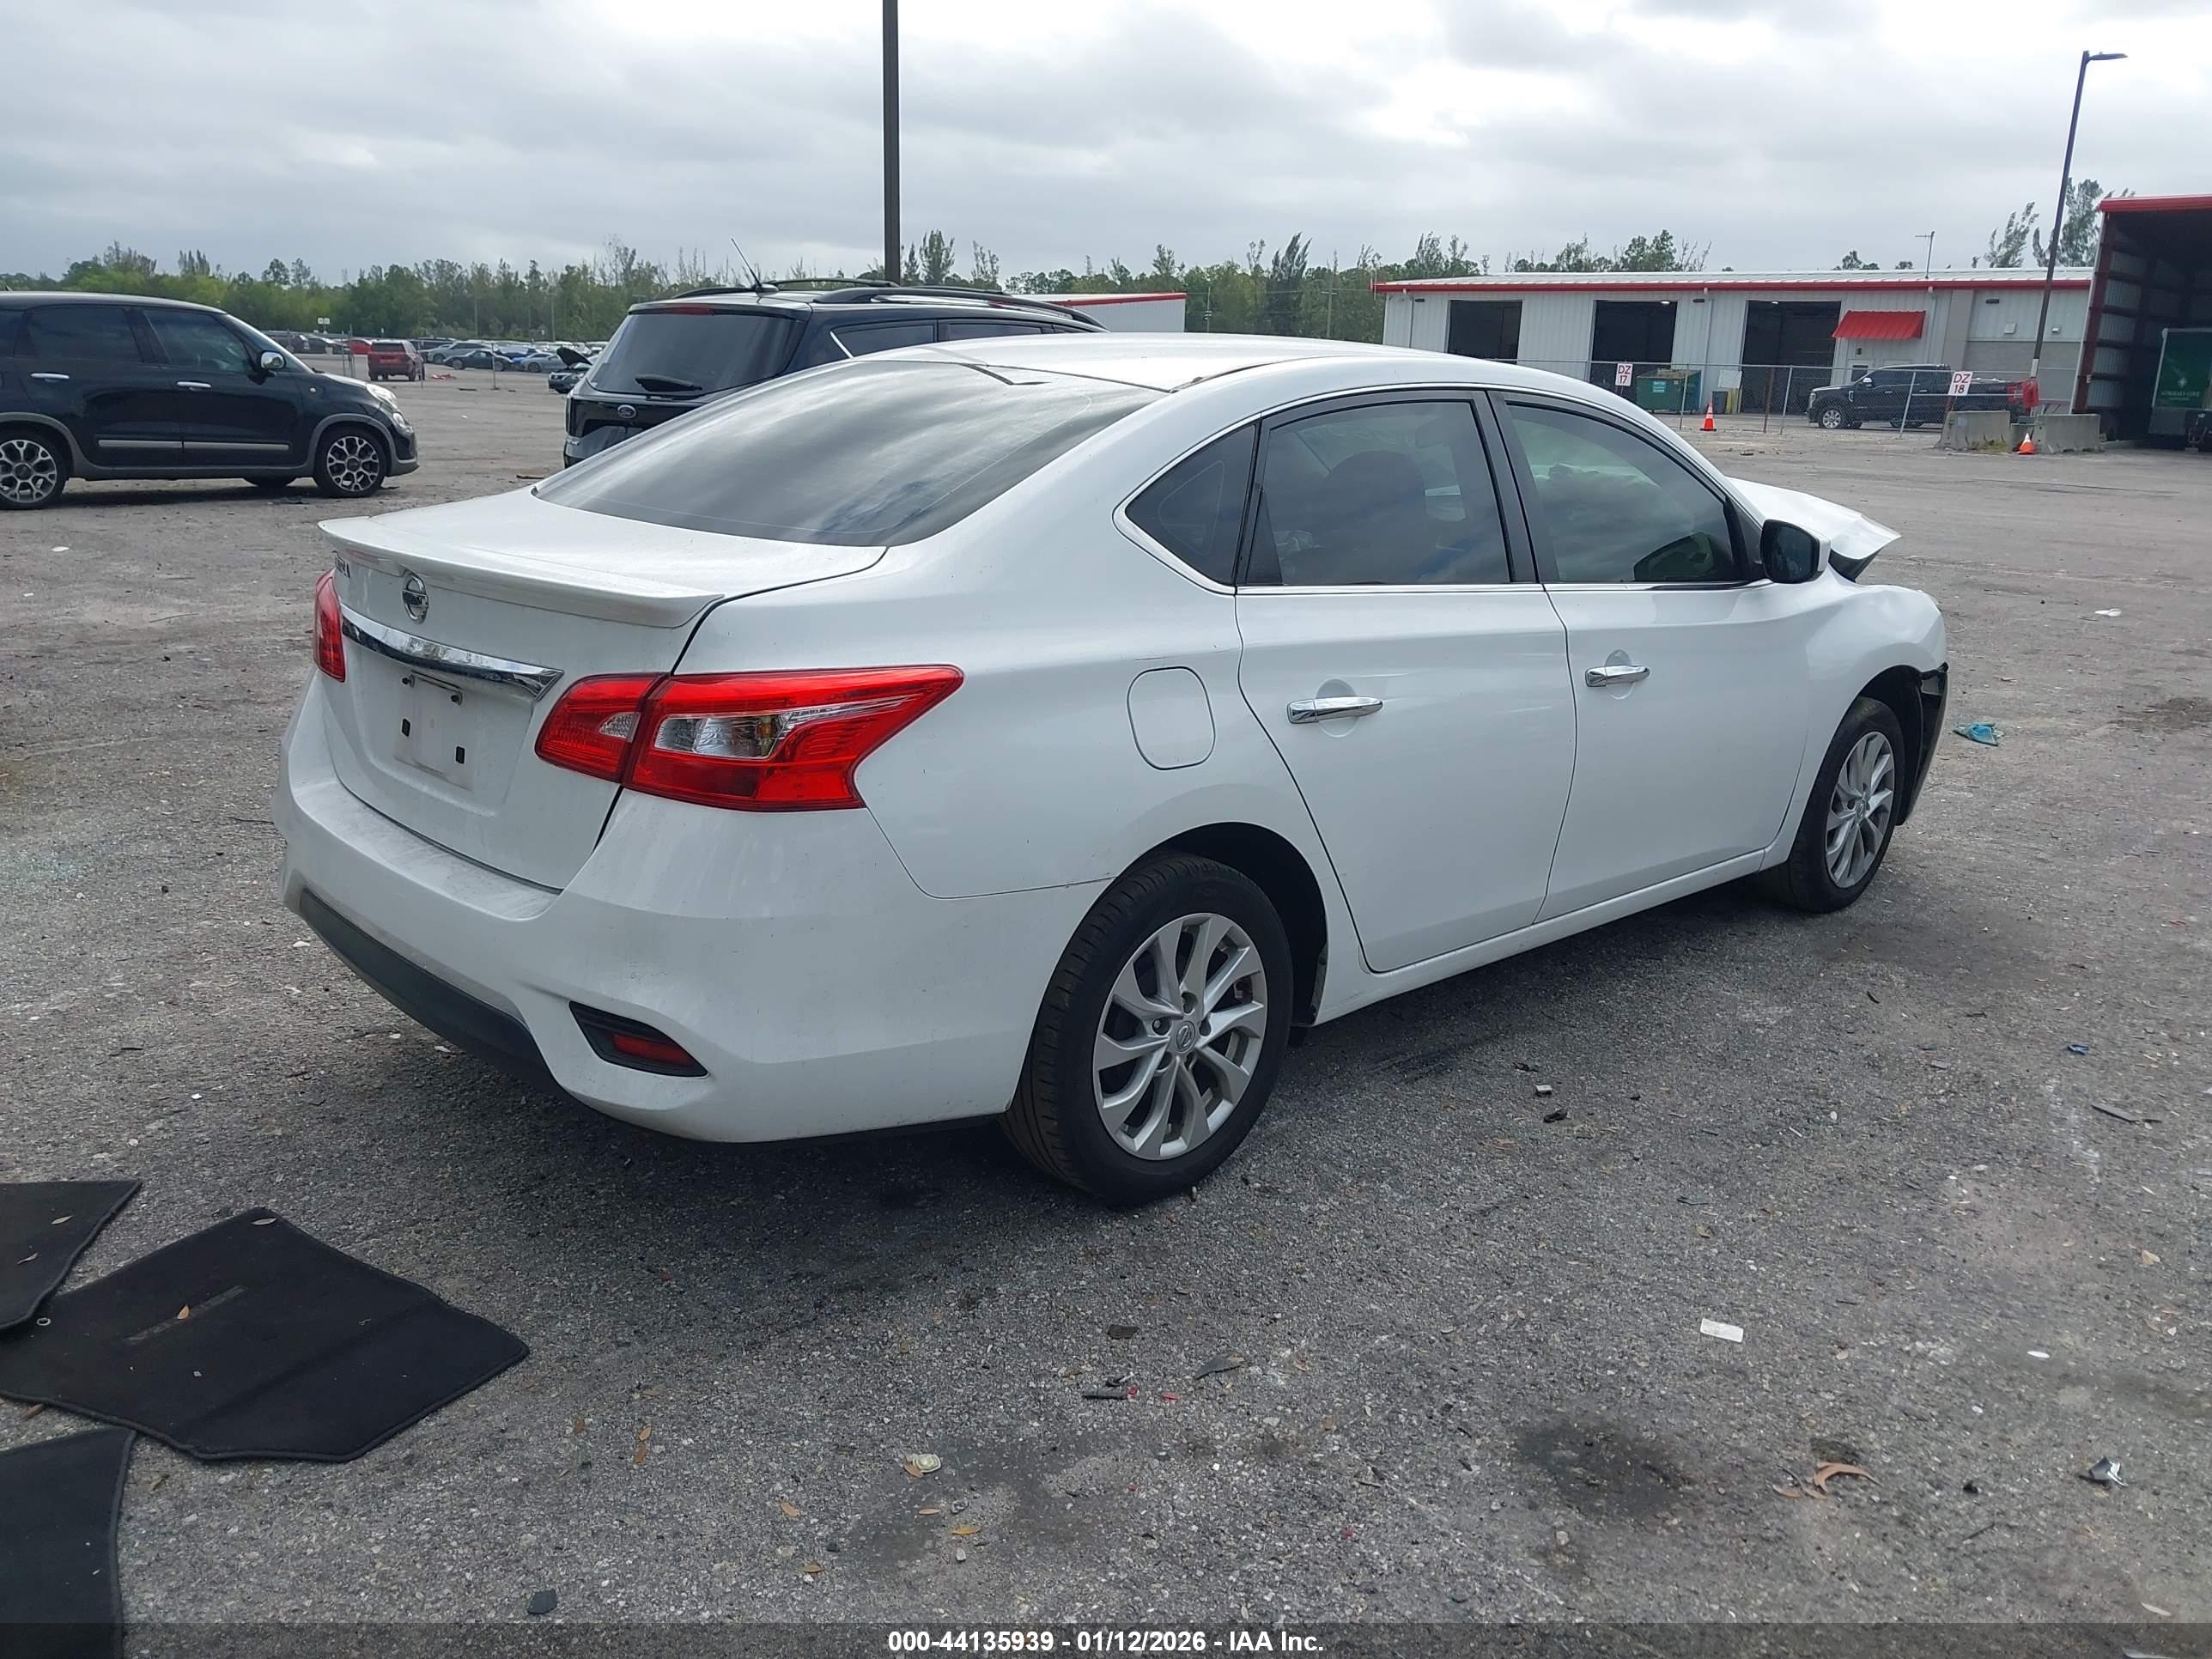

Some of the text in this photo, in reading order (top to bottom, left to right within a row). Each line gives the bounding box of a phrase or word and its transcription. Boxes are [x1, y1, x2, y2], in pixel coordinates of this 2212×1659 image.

[1618, 365, 1632, 375] DZ
[1620, 375, 1628, 385] 17
[1953, 374, 1971, 383] DZ
[1954, 384, 1965, 394] 18
